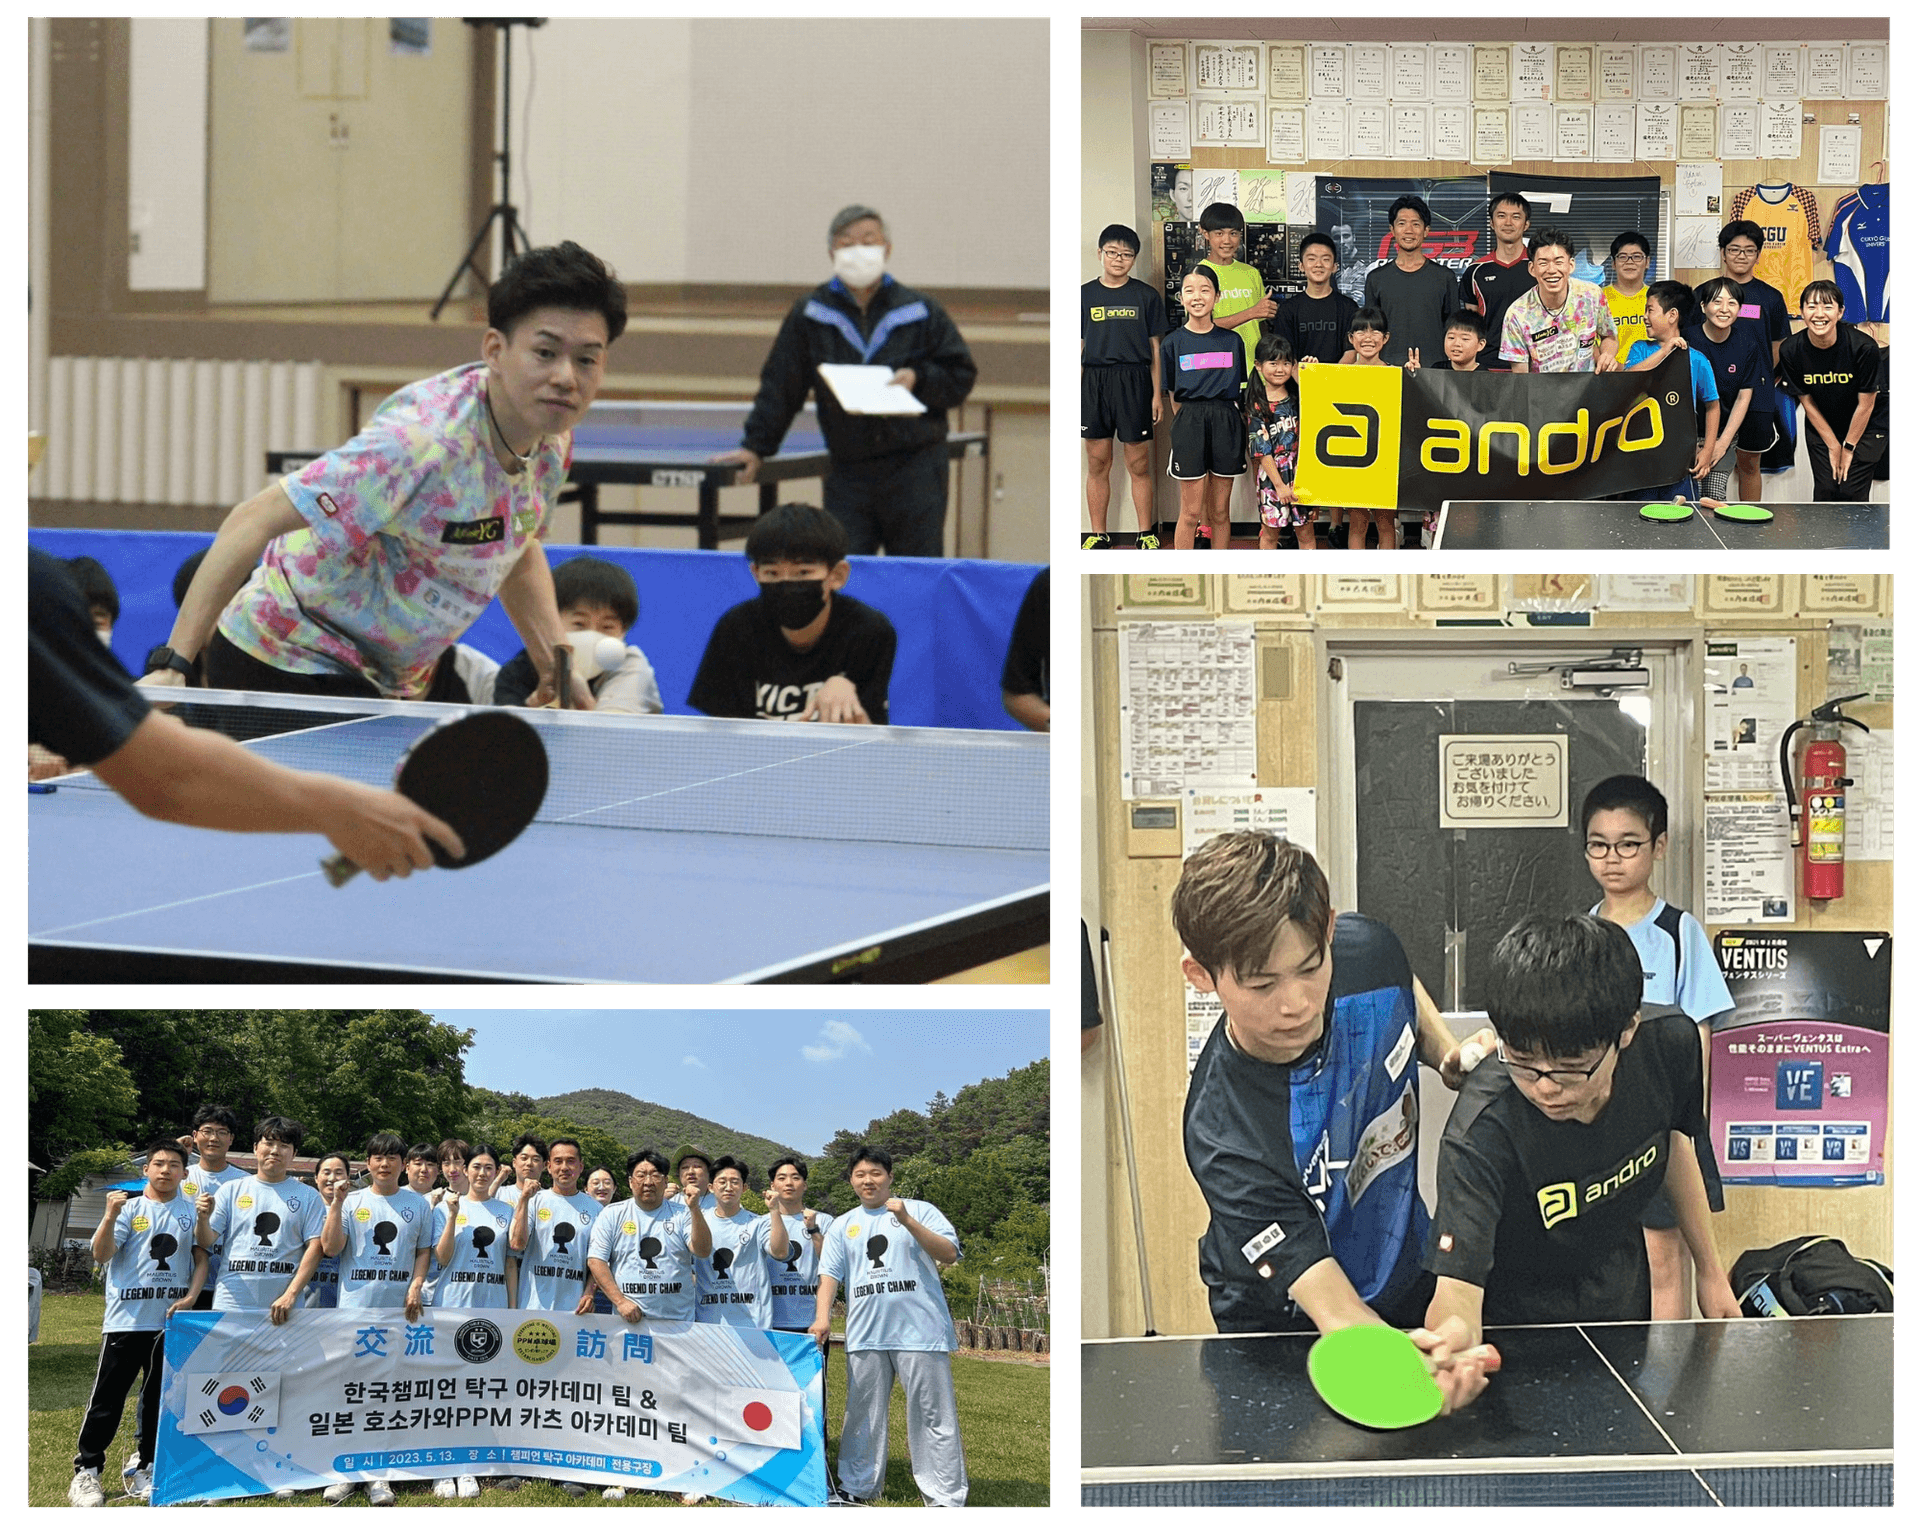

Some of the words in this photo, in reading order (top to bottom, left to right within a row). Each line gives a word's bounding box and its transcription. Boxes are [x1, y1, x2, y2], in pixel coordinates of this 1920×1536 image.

[1107, 308, 1136, 317] andro
[1299, 319, 1337, 332] andro
[1614, 314, 1645, 325] andr
[1803, 371, 1850, 384] andro
[1269, 415, 1298, 437] andr
[1419, 397, 1664, 479] andro
[1452, 753, 1556, 767] ご来場ありがとう
[1457, 768, 1538, 781] ございました
[1453, 782, 1530, 794] お気を付けて
[1721, 947, 1788, 970] VENTUS
[1757, 1033, 1843, 1043] スーパーヴェンタスは
[1585, 1145, 1657, 1203] andro
[229, 1260, 255, 1272] LEGEND
[258, 1261, 267, 1272] OF
[269, 1261, 295, 1274] CHAMP
[534, 1265, 555, 1276] LEGEND
[556, 1267, 564, 1277] OF
[565, 1268, 583, 1281] CHAM
[351, 1269, 377, 1280] LEGEND
[379, 1270, 387, 1281] OF
[451, 1272, 475, 1282] LEGEND
[477, 1272, 485, 1282] OF
[487, 1272, 505, 1285] CHAM
[121, 1287, 153, 1300] LEGEND
[156, 1287, 166, 1299] OF
[168, 1286, 189, 1298] CHAM
[622, 1282, 647, 1293] LEGEND
[649, 1283, 659, 1294] OF
[660, 1282, 682, 1293] CHAMP
[772, 1284, 788, 1295] GEND
[789, 1284, 798, 1295] OF
[800, 1284, 817, 1295] CHAM
[853, 1283, 874, 1298] LEGEND
[876, 1282, 885, 1294] OF
[887, 1280, 917, 1292] CHAMP
[720, 1293, 729, 1304] OF
[731, 1292, 755, 1304] CHAMP
[344, 1378, 457, 1404] 한국챔피언
[465, 1377, 508, 1400] 탁구
[516, 1378, 601, 1404] 아카데미
[612, 1385, 631, 1407] 팀
[640, 1389, 657, 1410] &
[309, 1411, 354, 1436] 일본
[363, 1406, 511, 1432] 호소카와PPM
[520, 1407, 563, 1429] 카츠
[571, 1411, 657, 1440] 아카데미
[668, 1422, 687, 1444] 팀
[510, 1449, 541, 1462] 챔피언
[542, 1452, 563, 1464] 탁구
[565, 1453, 606, 1469] 아카데미
[611, 1457, 653, 1475] 전용구장
